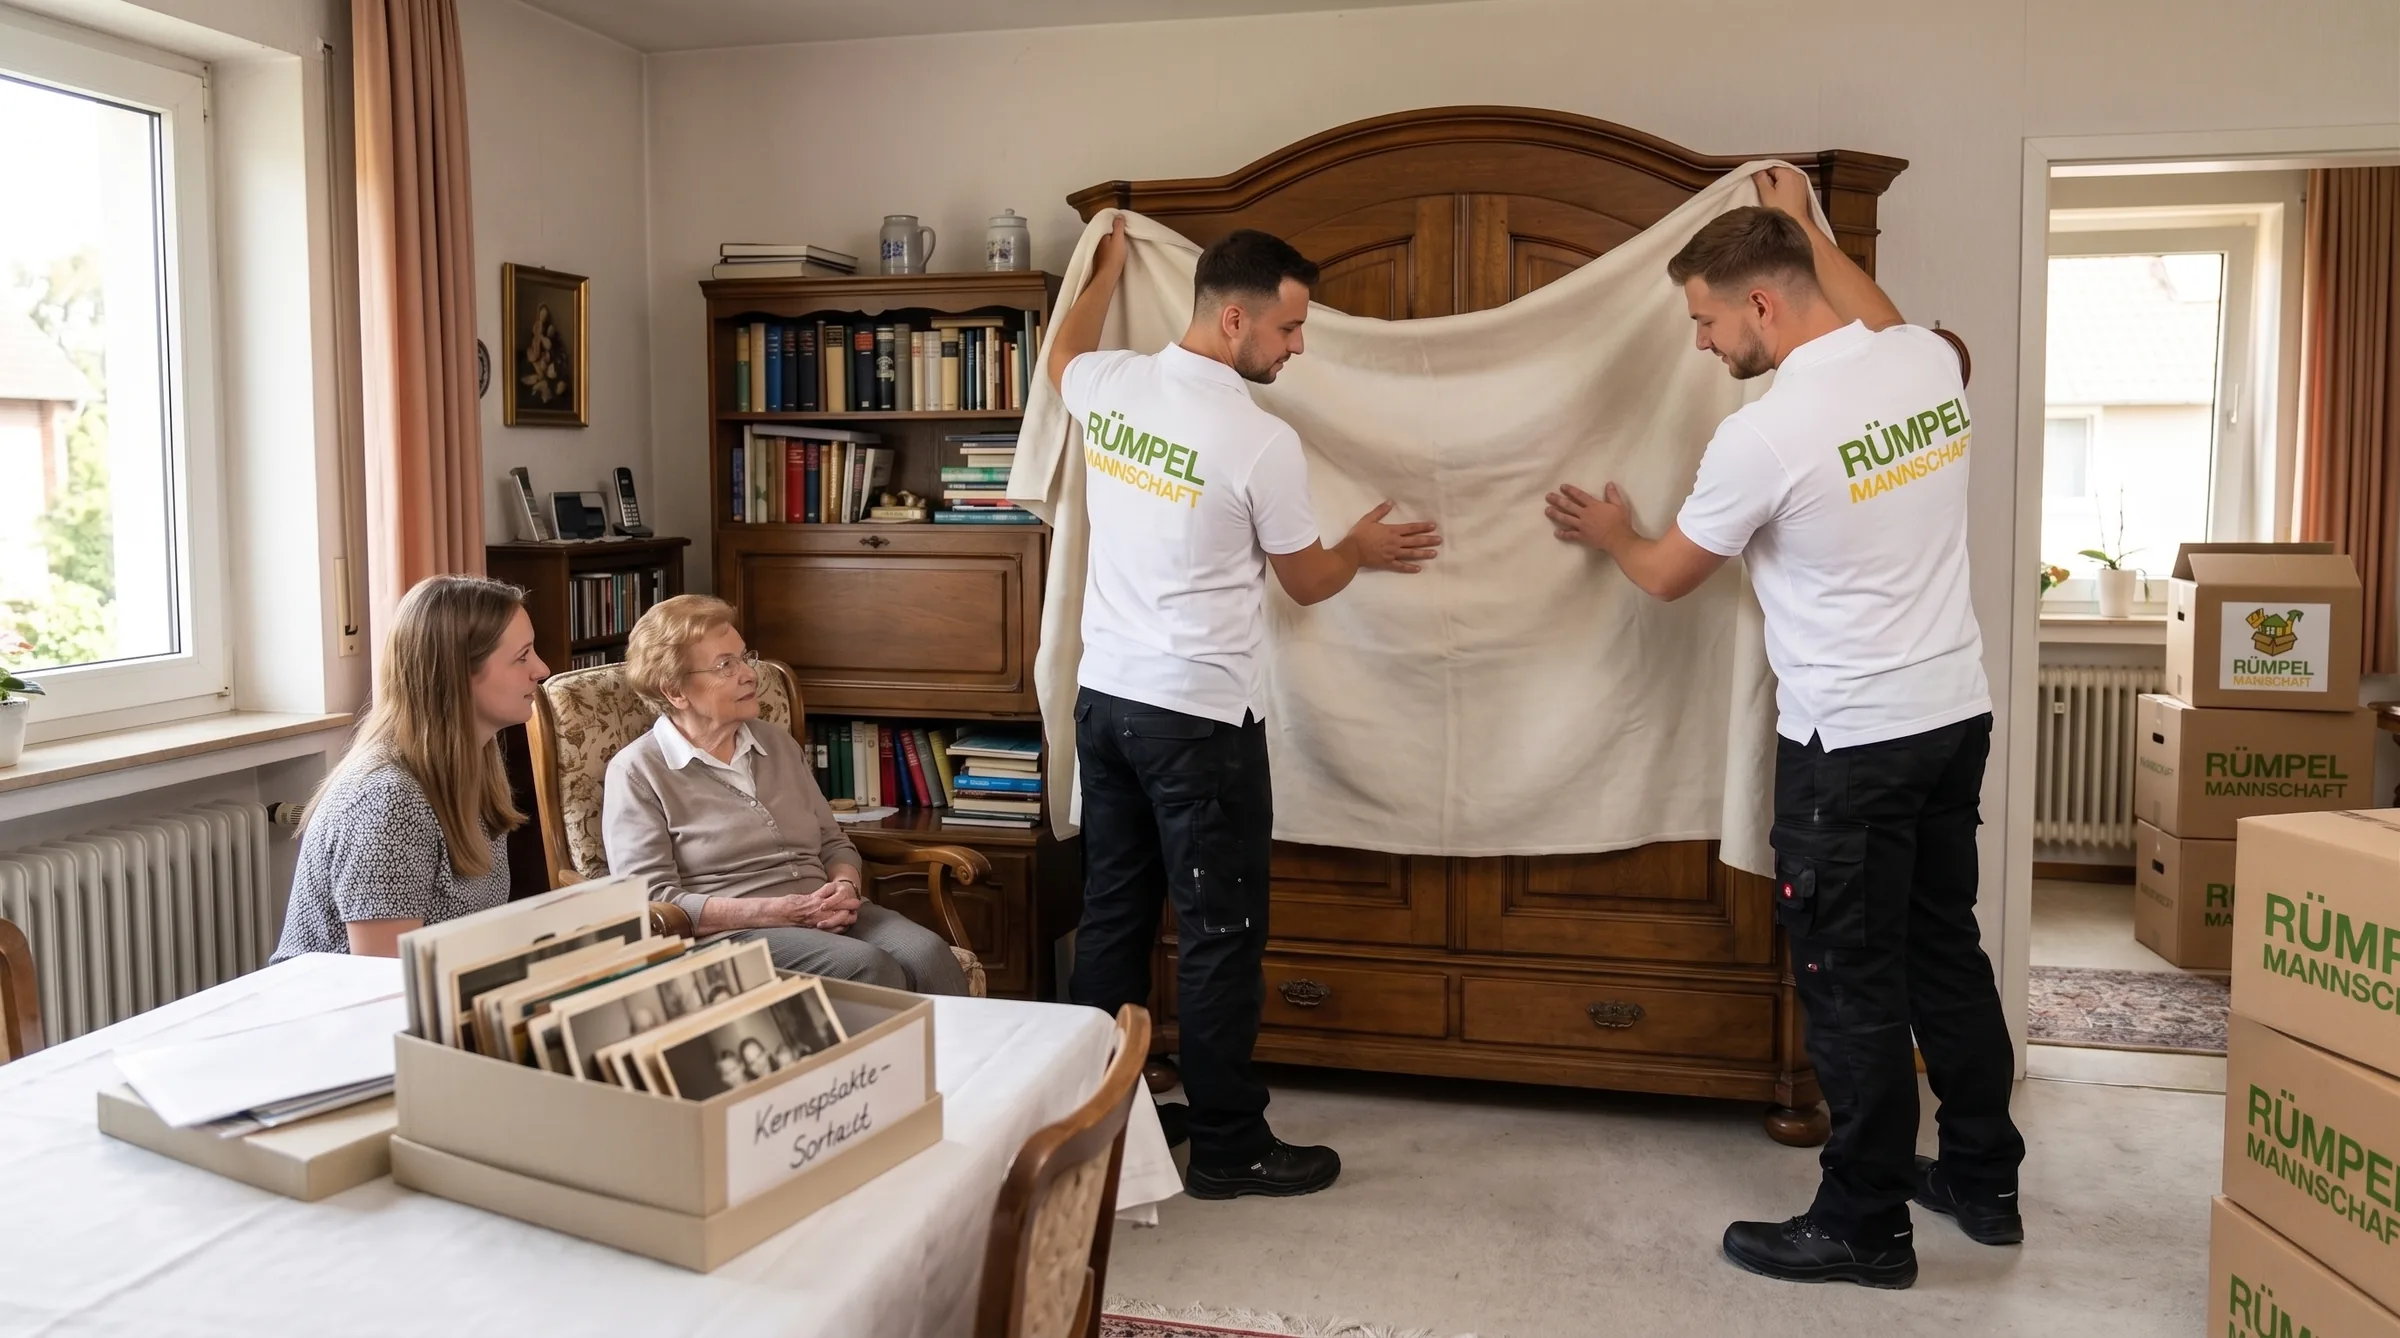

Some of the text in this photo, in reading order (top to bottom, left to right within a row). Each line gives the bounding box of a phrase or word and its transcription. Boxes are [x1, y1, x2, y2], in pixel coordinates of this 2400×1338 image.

[1087, 410, 1205, 486] RÜMPEL
[1838, 398, 1971, 478] RÜMPEL
[1850, 432, 1971, 504] MANNSCHAF
[1085, 445, 1203, 508] MANNSCHAFT
[2233, 656, 2315, 676] RÜMPEL
[2205, 781, 2348, 799] MANNSCHAFT
[2206, 746, 2349, 779] RÜMPEL
[2263, 943, 2400, 1016] MANNSC
